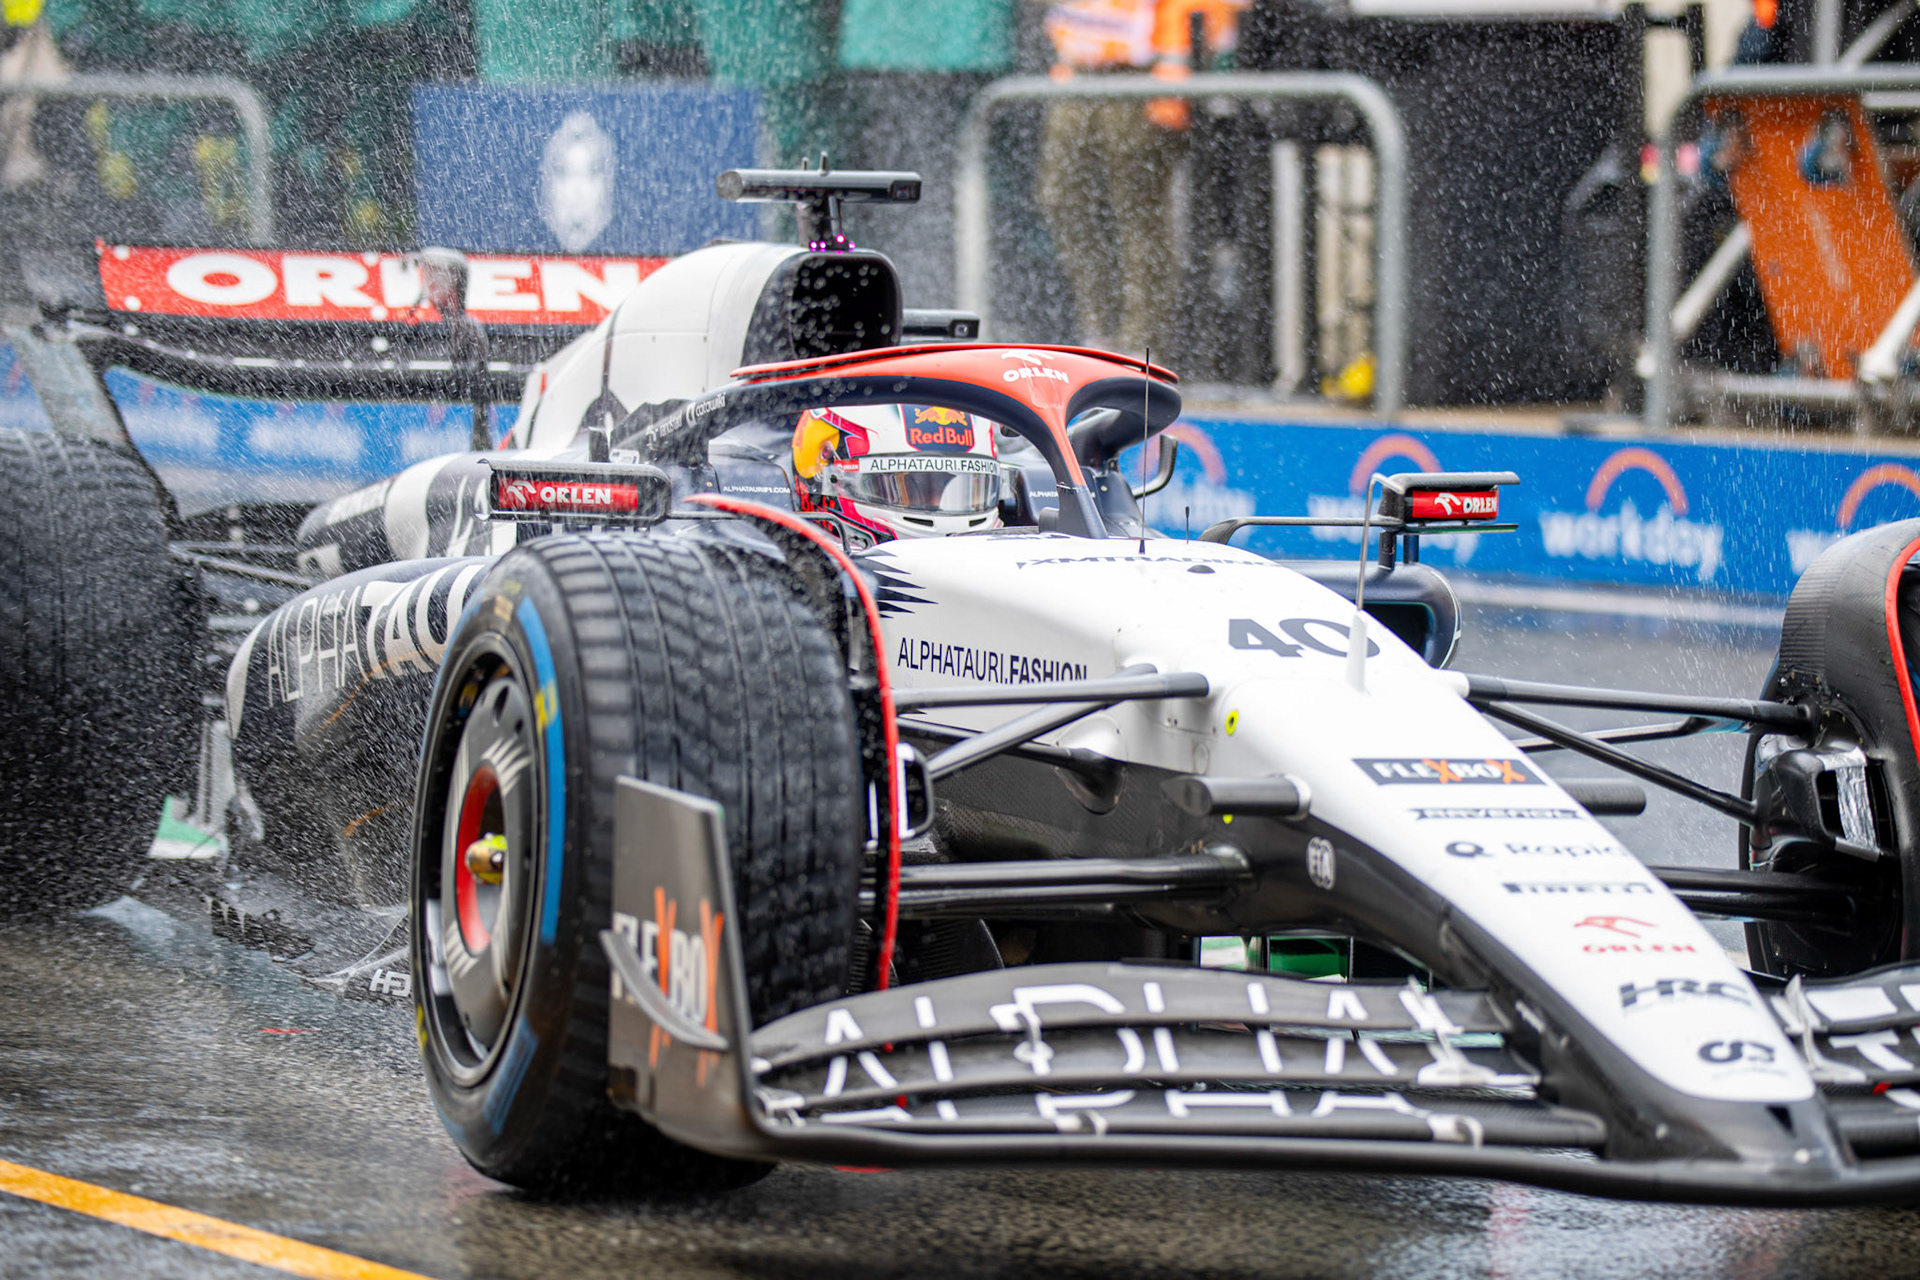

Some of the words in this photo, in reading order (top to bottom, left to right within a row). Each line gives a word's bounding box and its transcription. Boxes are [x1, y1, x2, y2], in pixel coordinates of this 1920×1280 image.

[1003, 366, 1069, 384] ORLEN
[909, 427, 942, 446] Red
[945, 426, 974, 447] Bull
[540, 486, 612, 505] ORLEN
[1463, 497, 1498, 513] ORLEN
[1228, 618, 1381, 659] 40
[898, 637, 1088, 685] ALPHATAURI.FASHION
[1370, 758, 1526, 785] FLEXBOX
